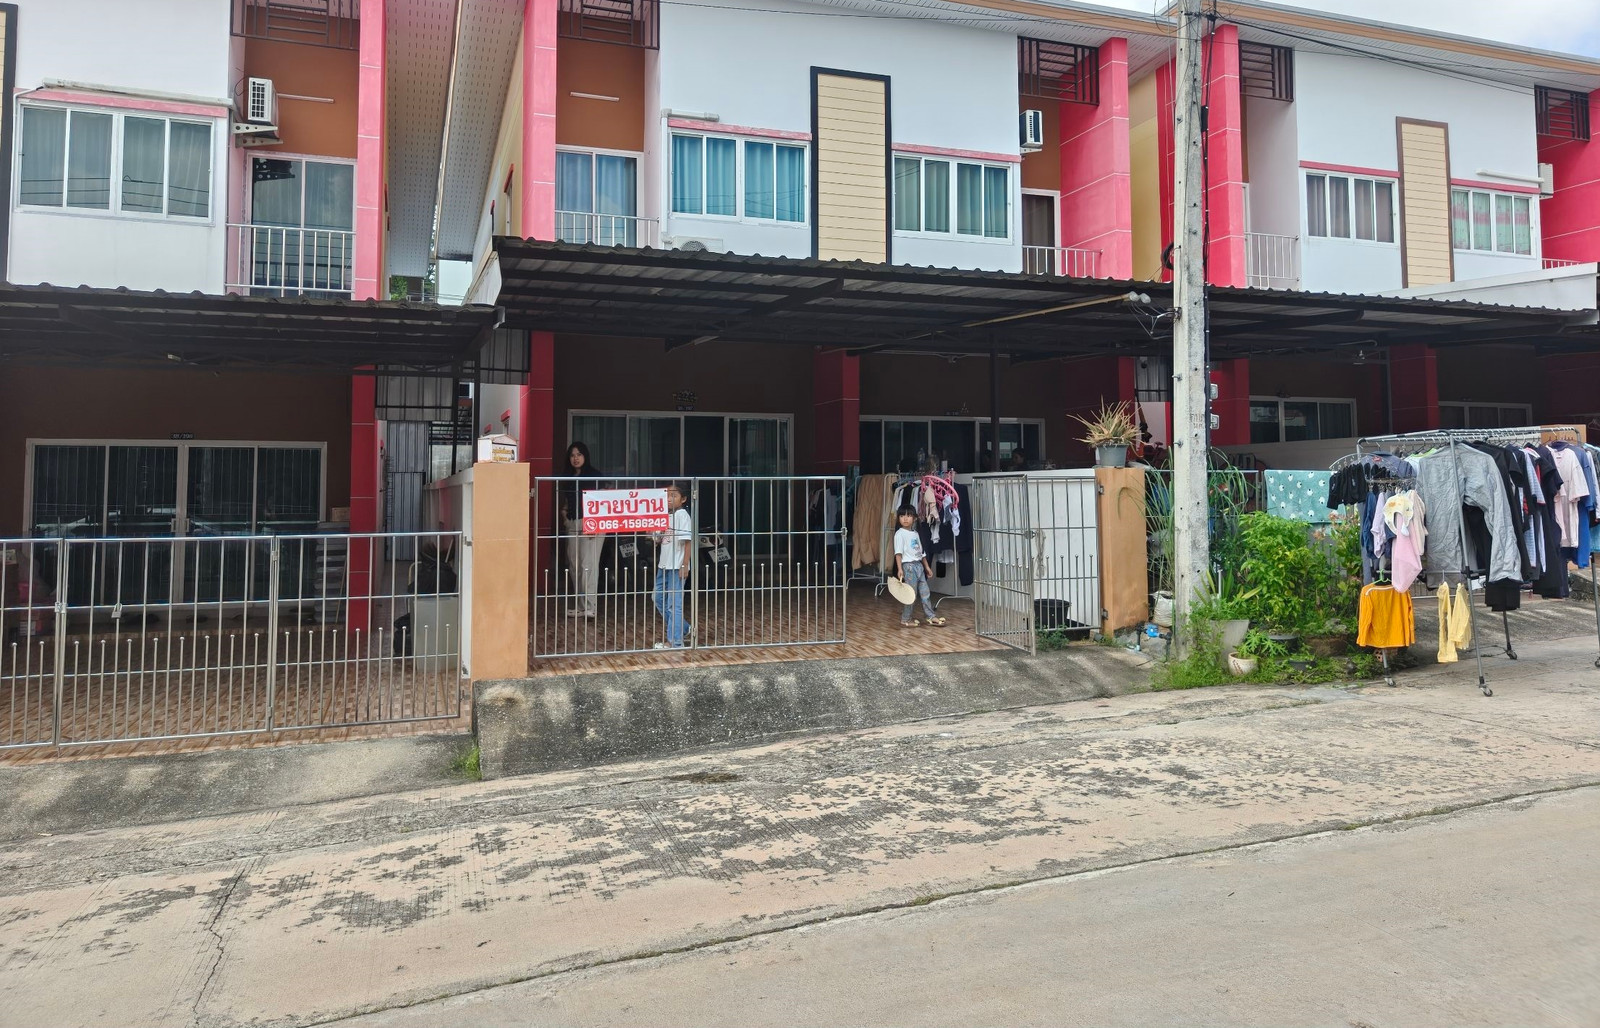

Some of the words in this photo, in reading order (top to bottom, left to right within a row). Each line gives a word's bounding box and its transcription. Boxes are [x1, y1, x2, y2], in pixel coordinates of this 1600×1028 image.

[587, 491, 664, 515] ขายบ้าน
[599, 518, 667, 530] 066-1596242
